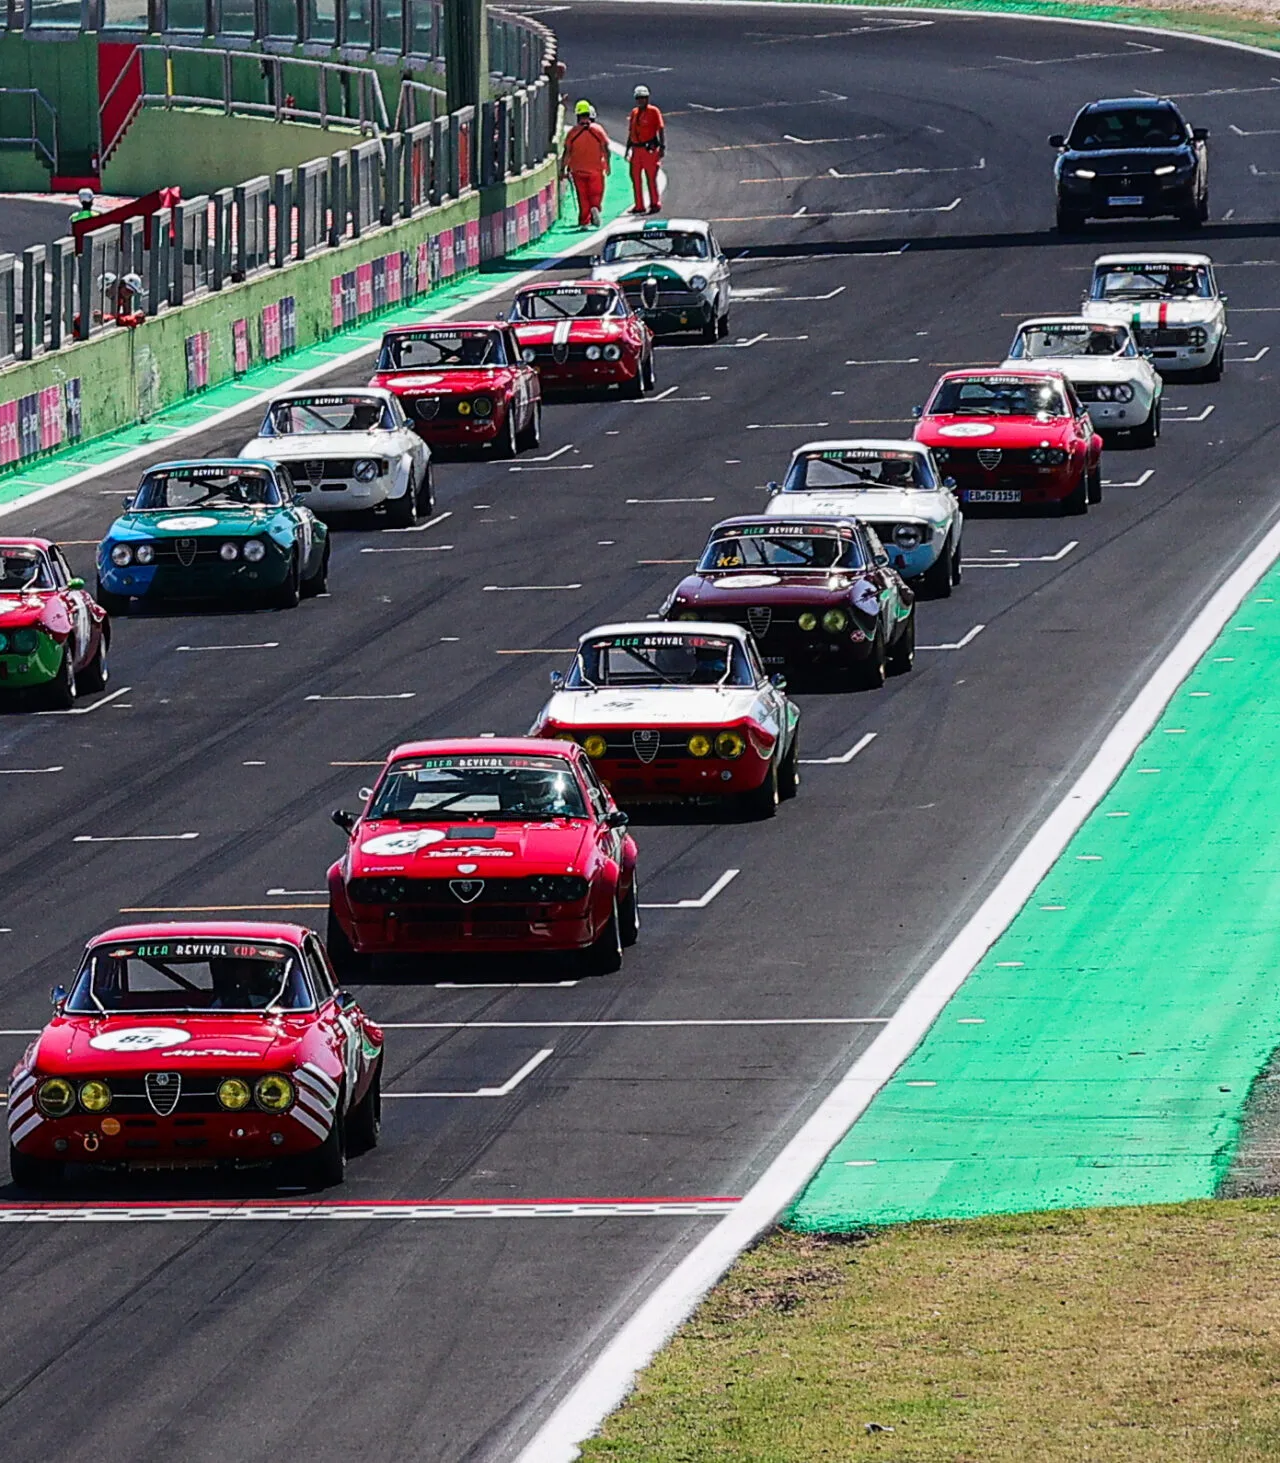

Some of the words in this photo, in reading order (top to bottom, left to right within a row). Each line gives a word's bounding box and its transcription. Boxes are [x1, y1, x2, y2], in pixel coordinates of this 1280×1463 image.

[644, 636, 684, 646] REVIVAL
[459, 758, 503, 767] REVIVAL
[138, 945, 168, 956] ALFA
[176, 944, 227, 956] REVIVAL
[234, 946, 258, 956] CUP
[119, 1034, 155, 1044] 85
